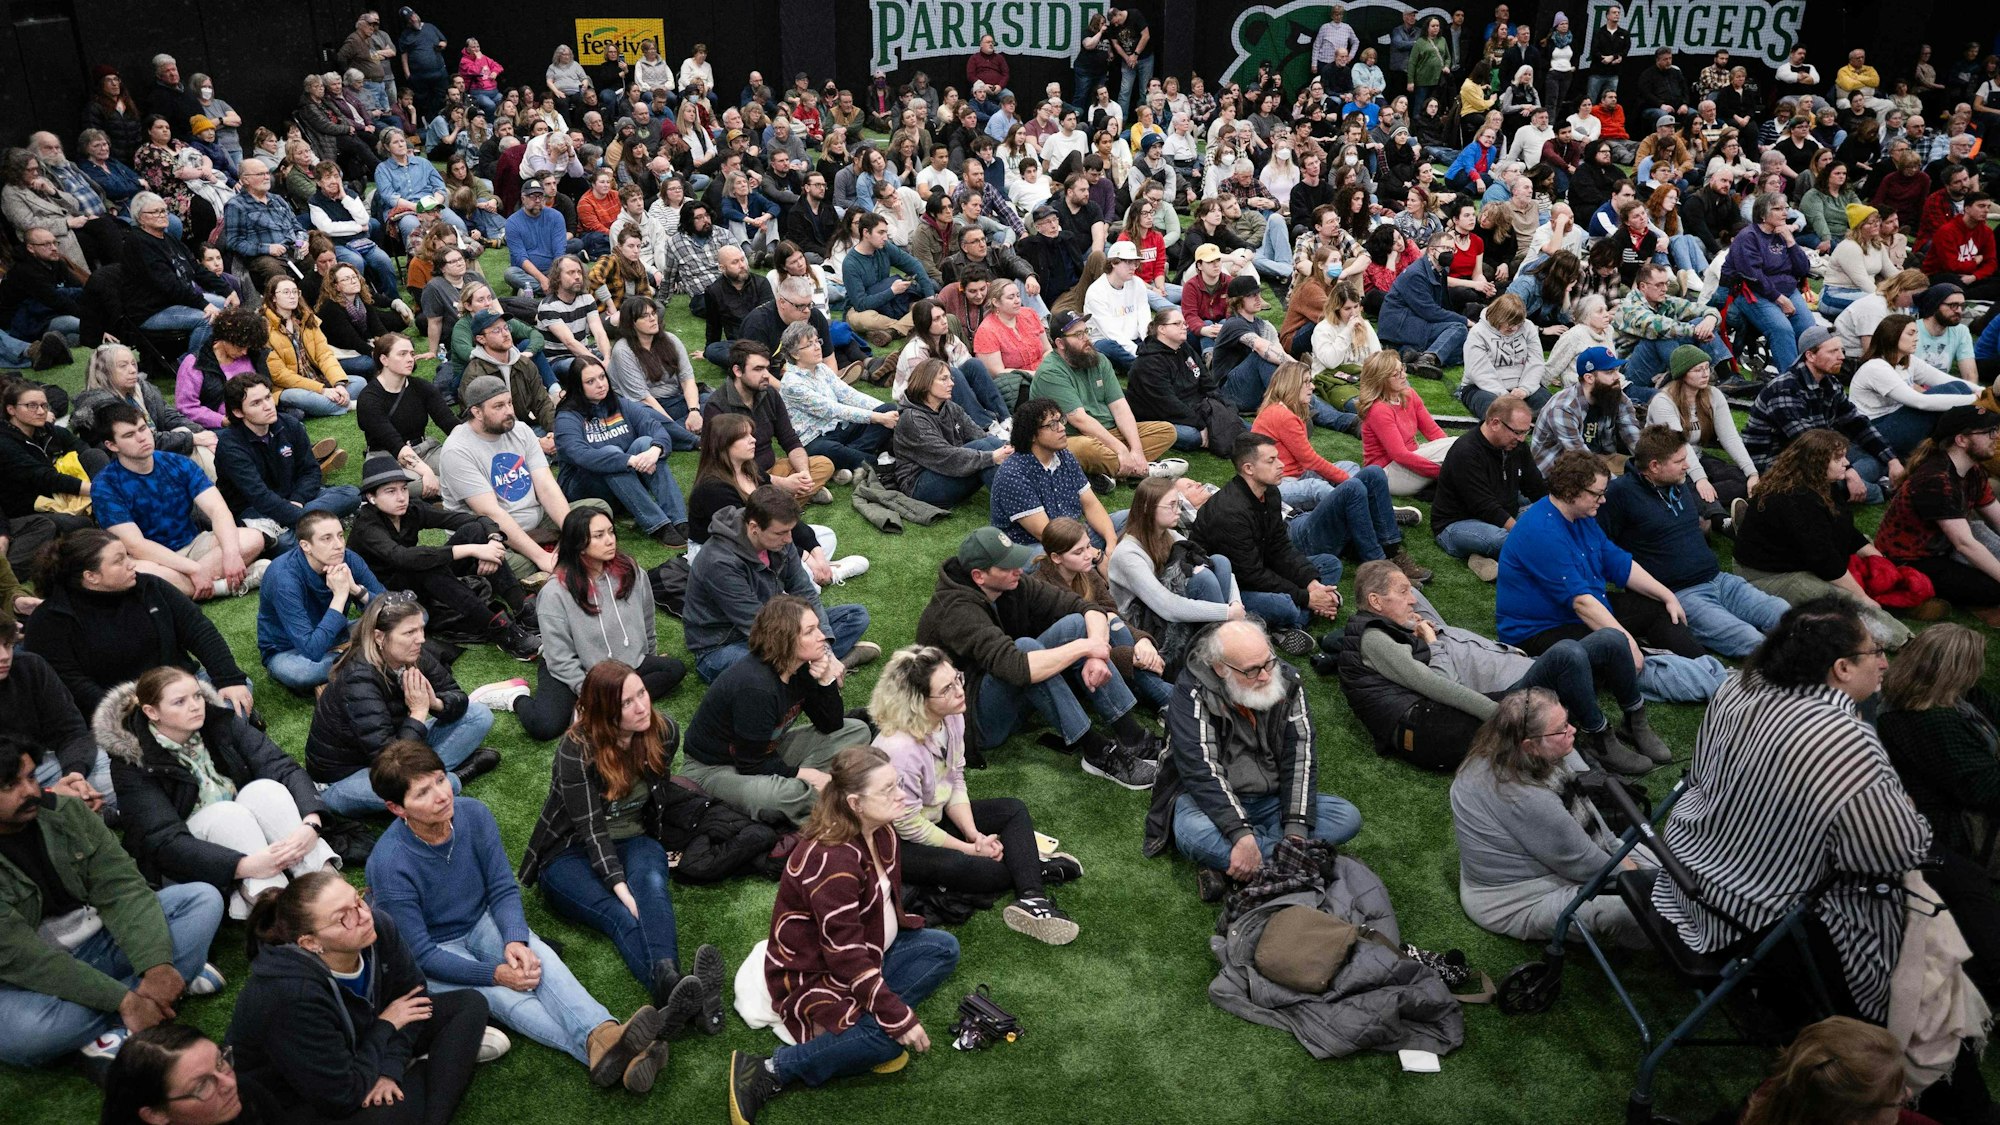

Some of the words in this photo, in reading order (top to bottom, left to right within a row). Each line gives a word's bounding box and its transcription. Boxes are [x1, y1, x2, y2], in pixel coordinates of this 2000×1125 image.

[581, 33, 661, 55] fetivl
[586, 424, 630, 444] VERMONT
[494, 466, 530, 487] NASA
